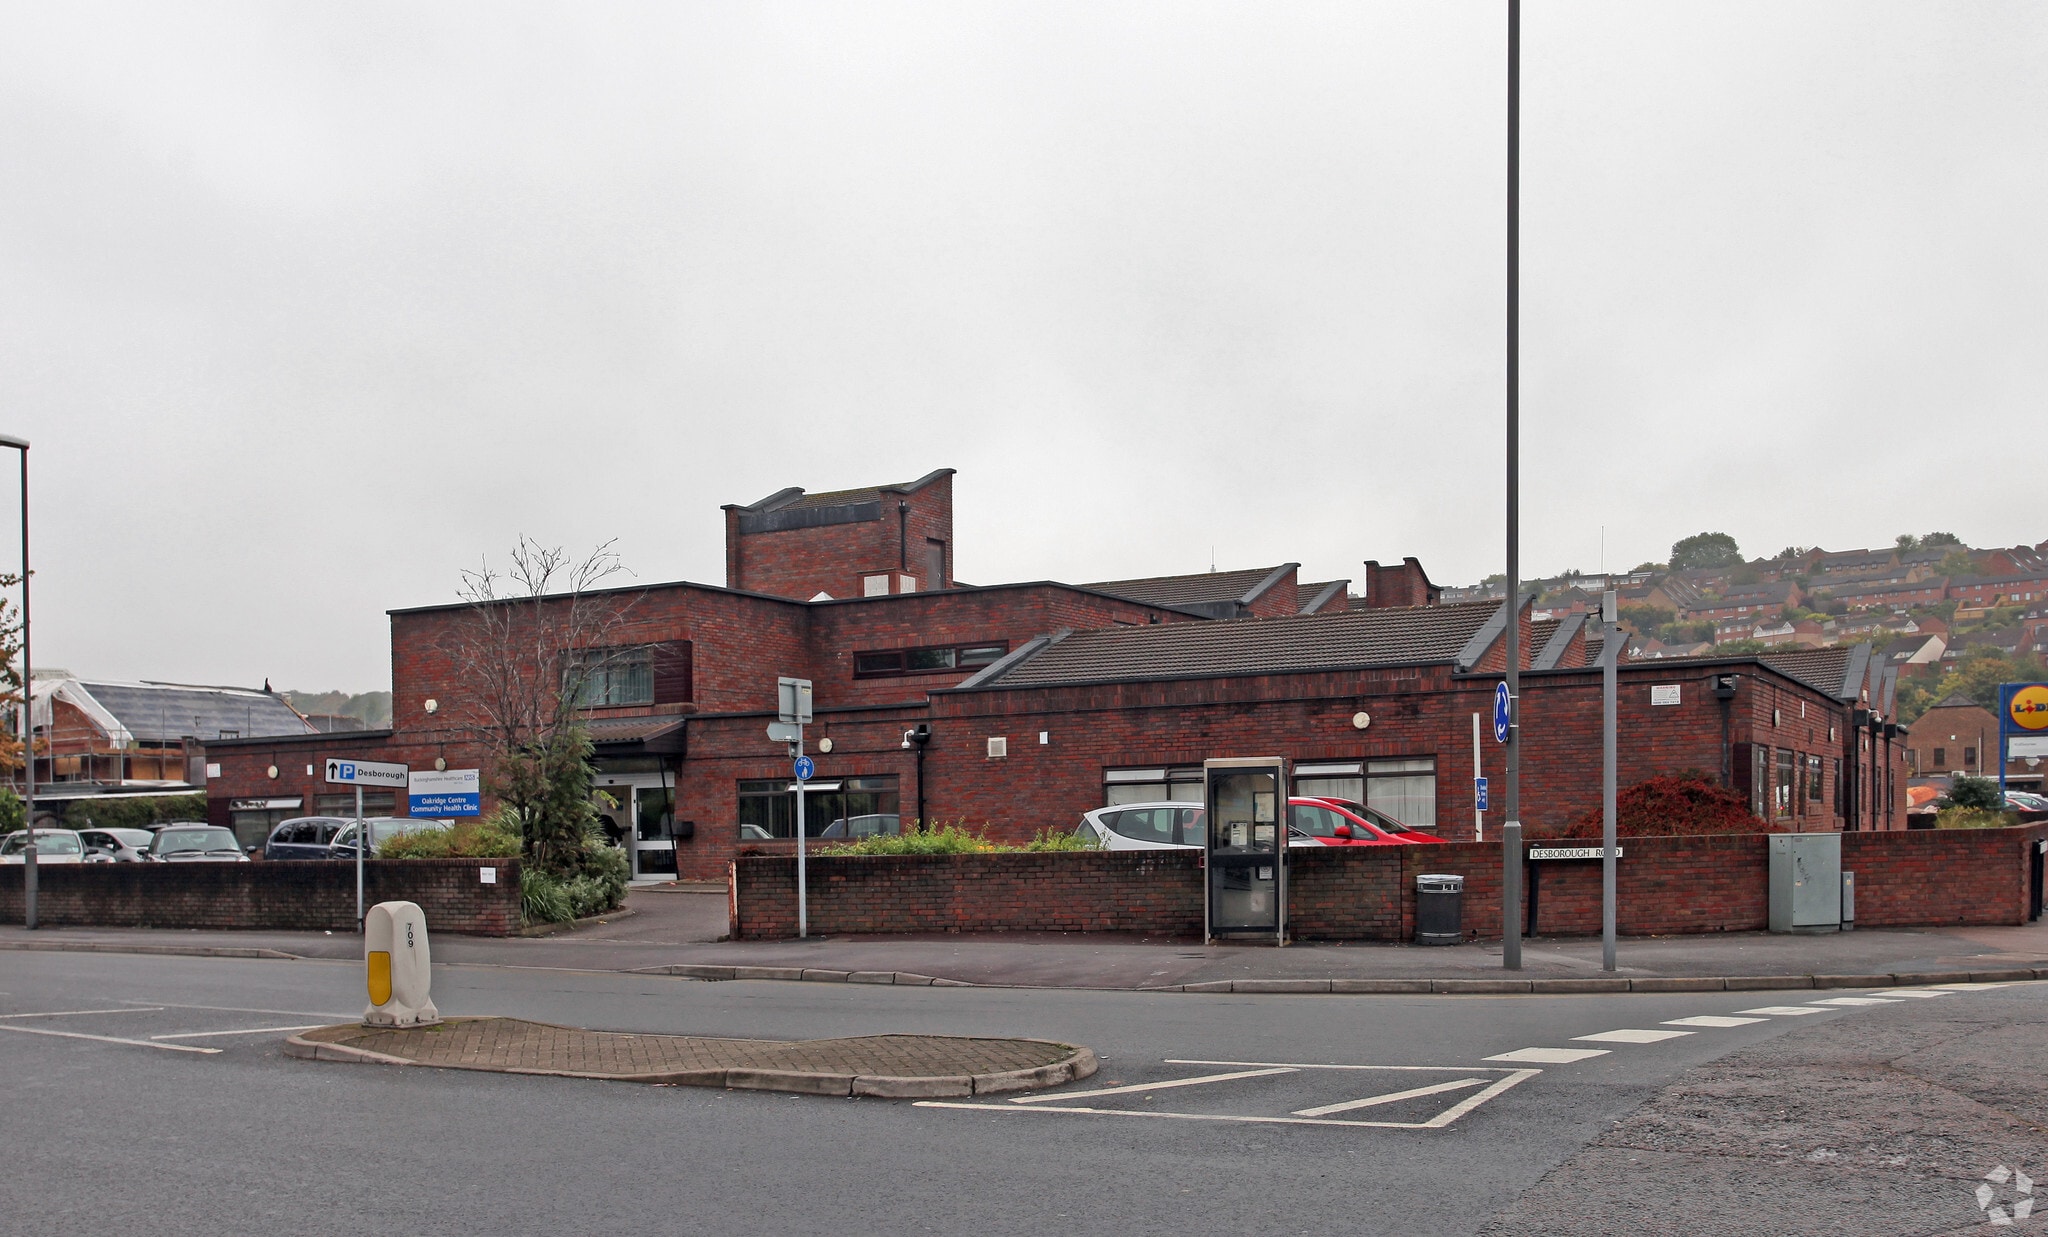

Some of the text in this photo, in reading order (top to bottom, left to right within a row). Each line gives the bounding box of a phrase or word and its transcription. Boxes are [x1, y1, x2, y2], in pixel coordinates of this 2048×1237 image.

[357, 768, 405, 780] Desborough
[422, 796, 446, 805] Oakridge
[1532, 848, 1620, 858] DESBOROUGH ROD
